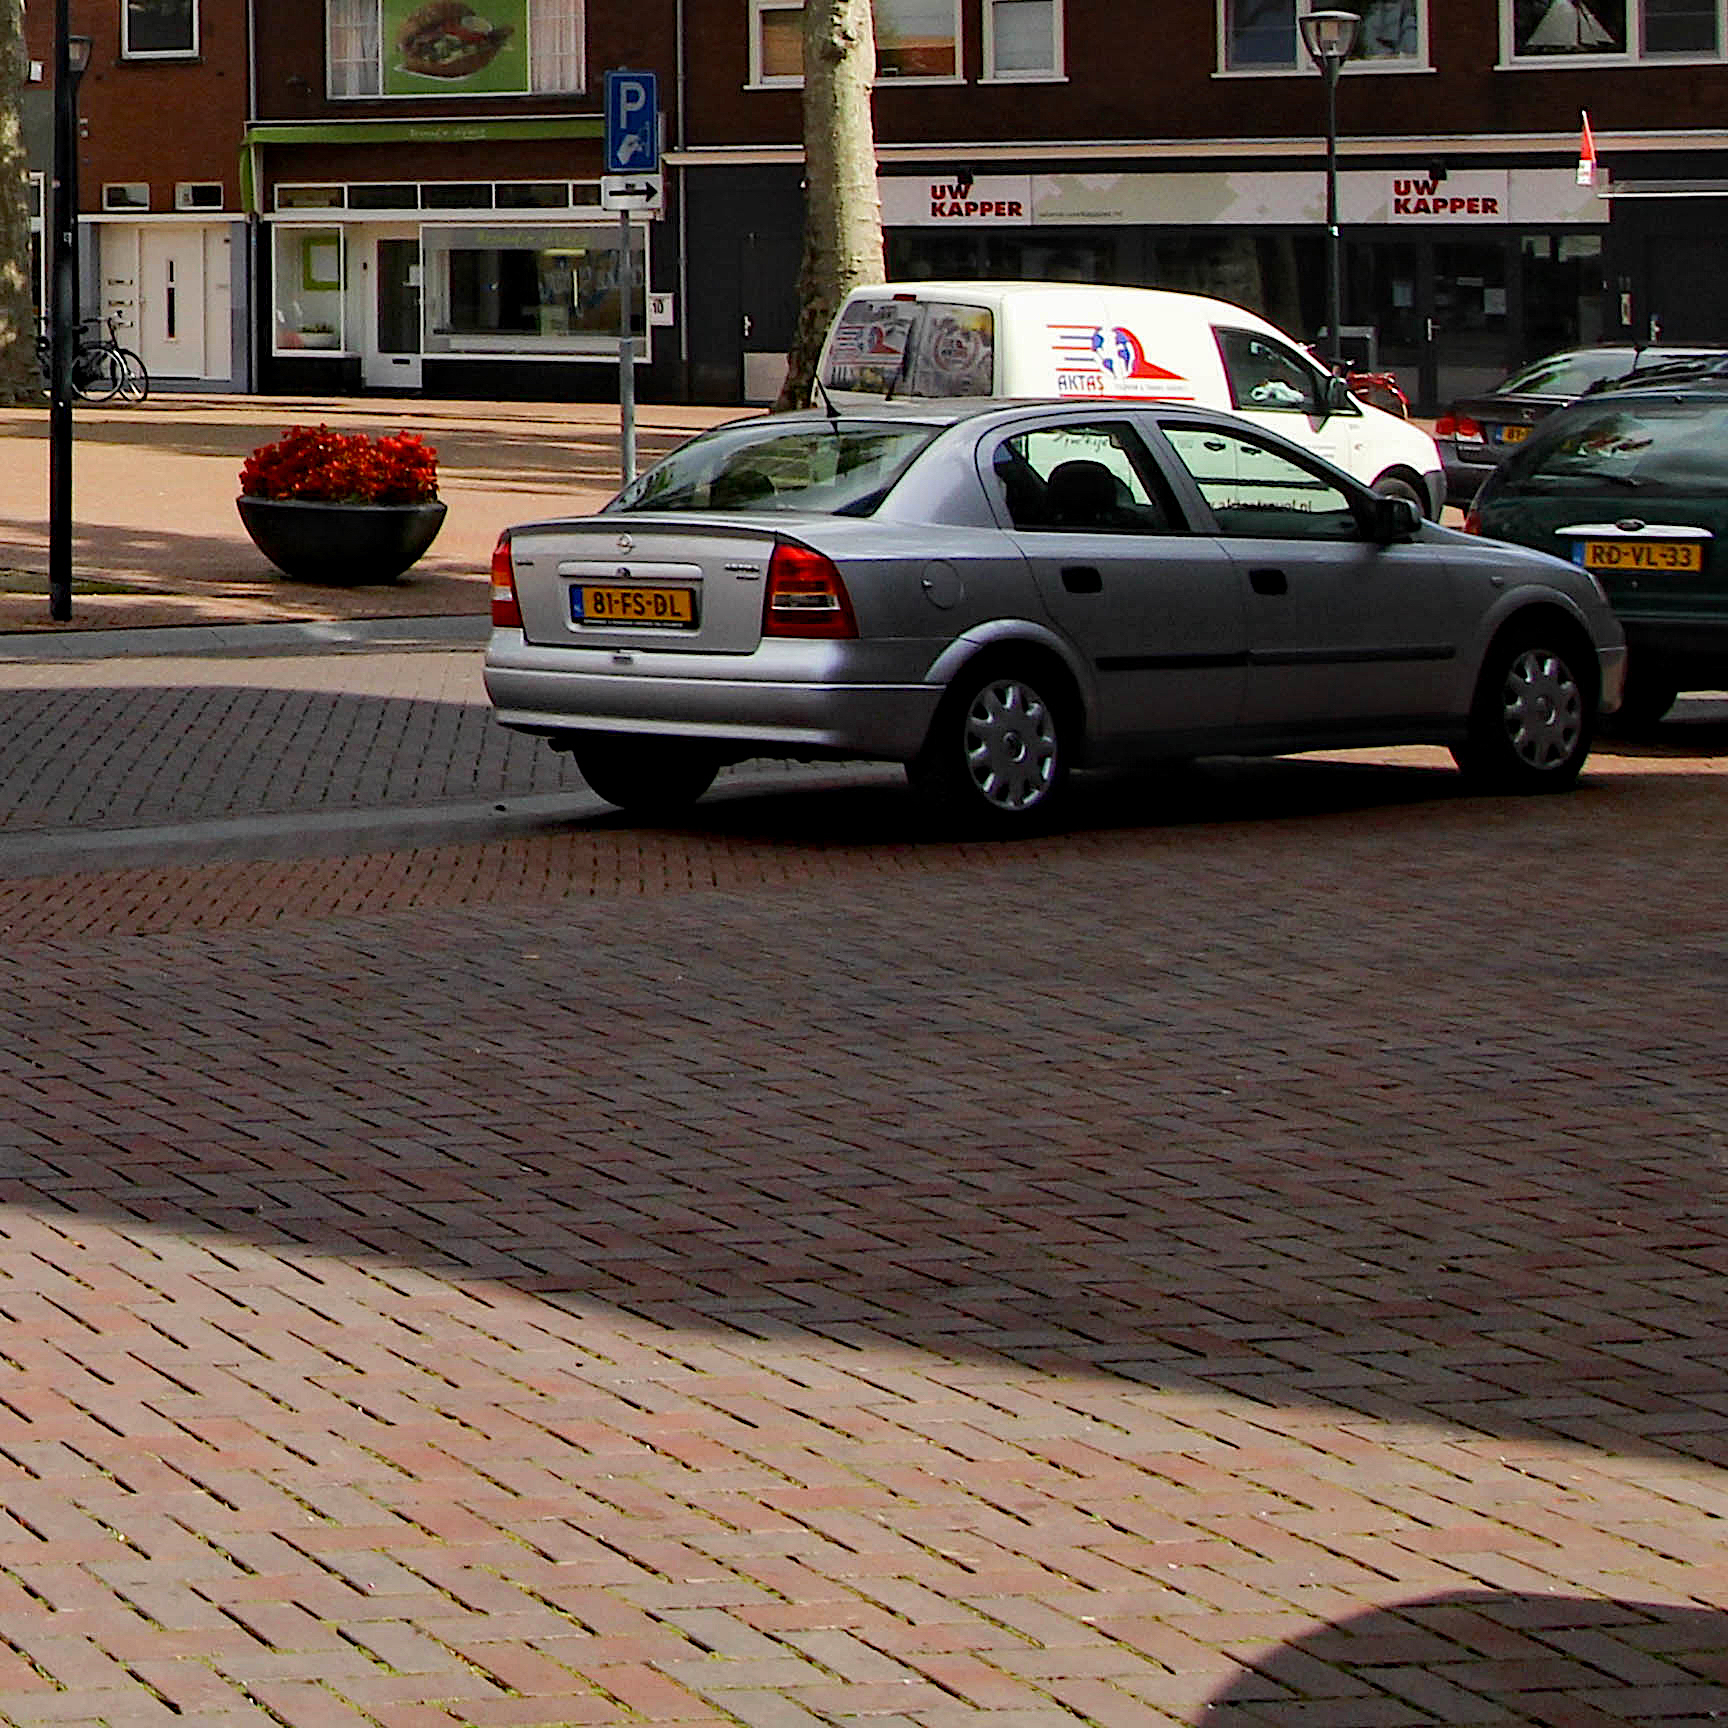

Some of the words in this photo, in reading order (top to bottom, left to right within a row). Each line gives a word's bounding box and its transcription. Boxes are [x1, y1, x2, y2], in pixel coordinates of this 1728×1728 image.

[620, 81, 646, 129] P
[930, 184, 972, 200] UW
[1393, 179, 1439, 196] UW
[930, 201, 1023, 217] KAPPER
[1393, 197, 1499, 215] KAPPER
[1057, 375, 1105, 392] AKTAS
[1590, 544, 1693, 569] RD-VL-33
[593, 590, 682, 618] 81-FS-DL
